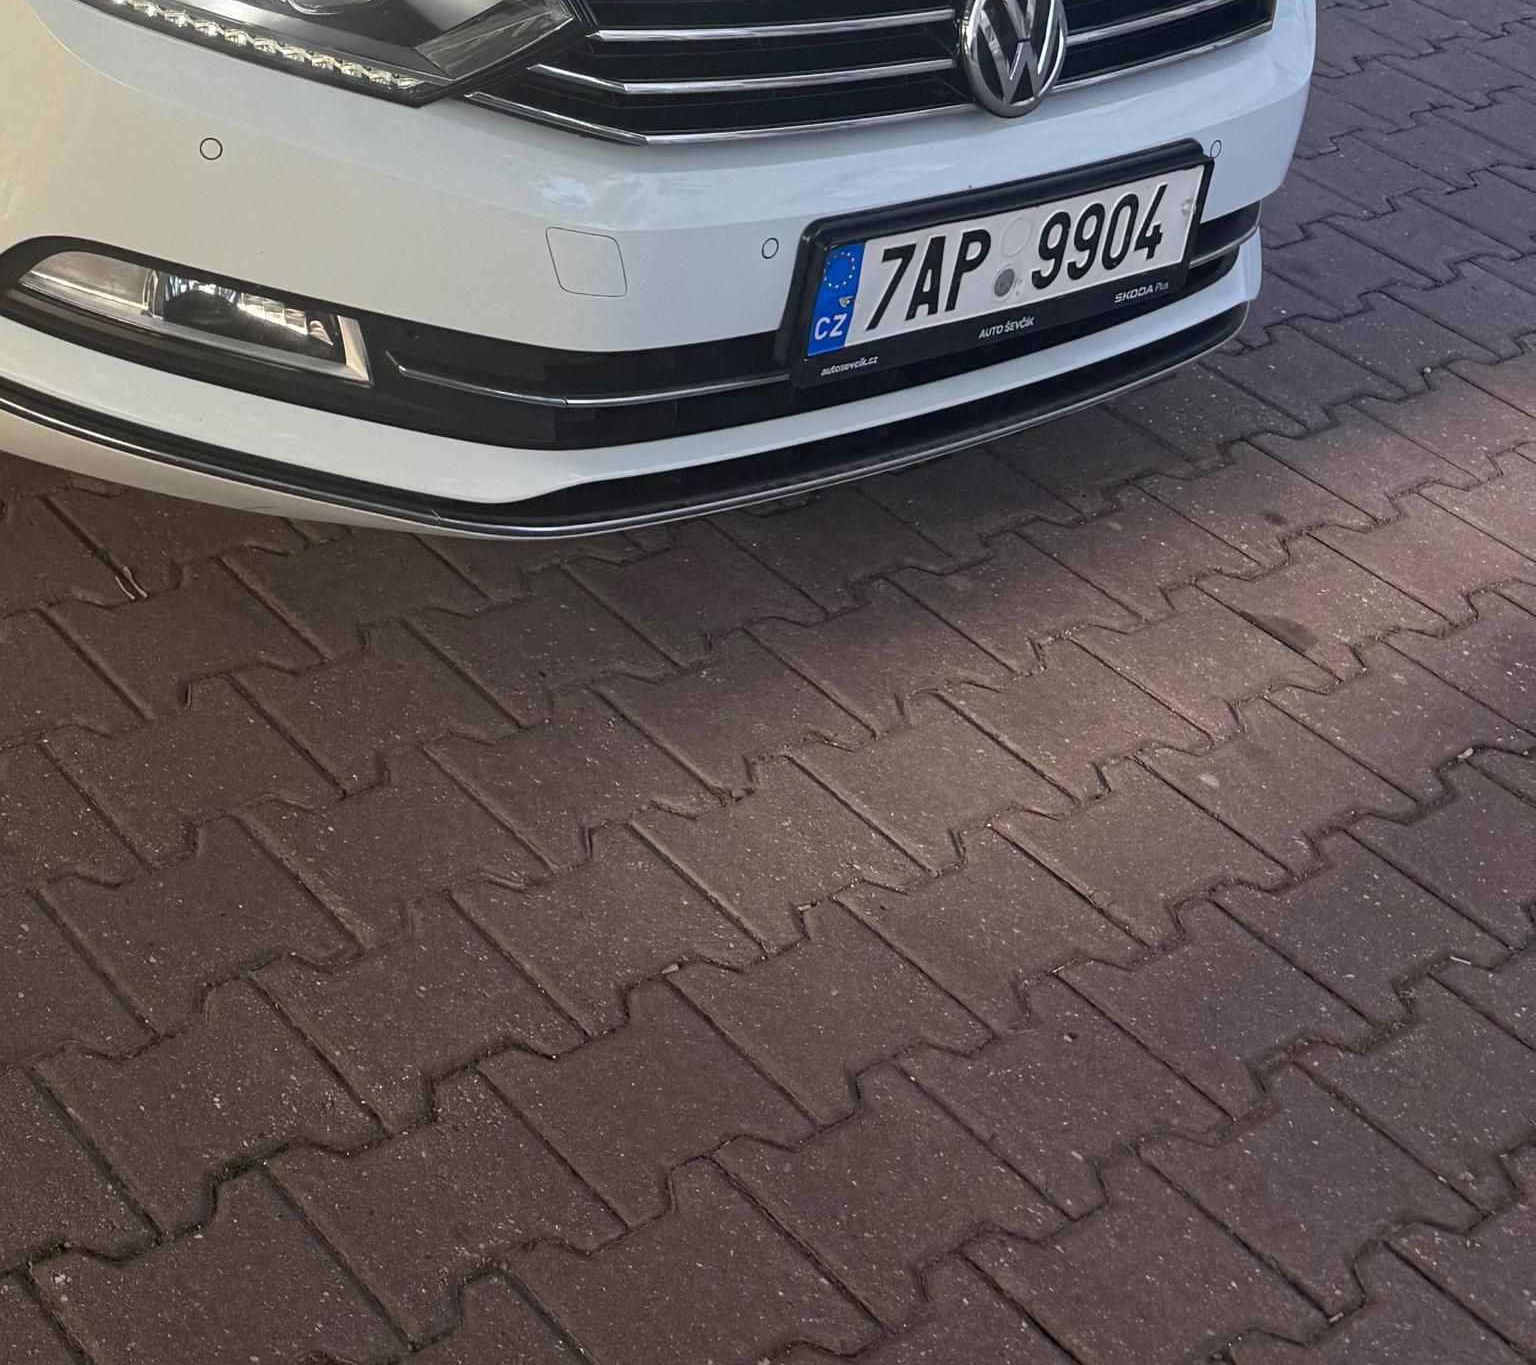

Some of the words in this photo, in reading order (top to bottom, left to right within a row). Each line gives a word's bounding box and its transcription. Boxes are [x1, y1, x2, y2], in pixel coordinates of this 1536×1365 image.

[865, 228, 991, 332] 7AP
[1030, 184, 1168, 290] 9904
[814, 313, 844, 342] CZ
[978, 324, 1004, 340] AUTO
